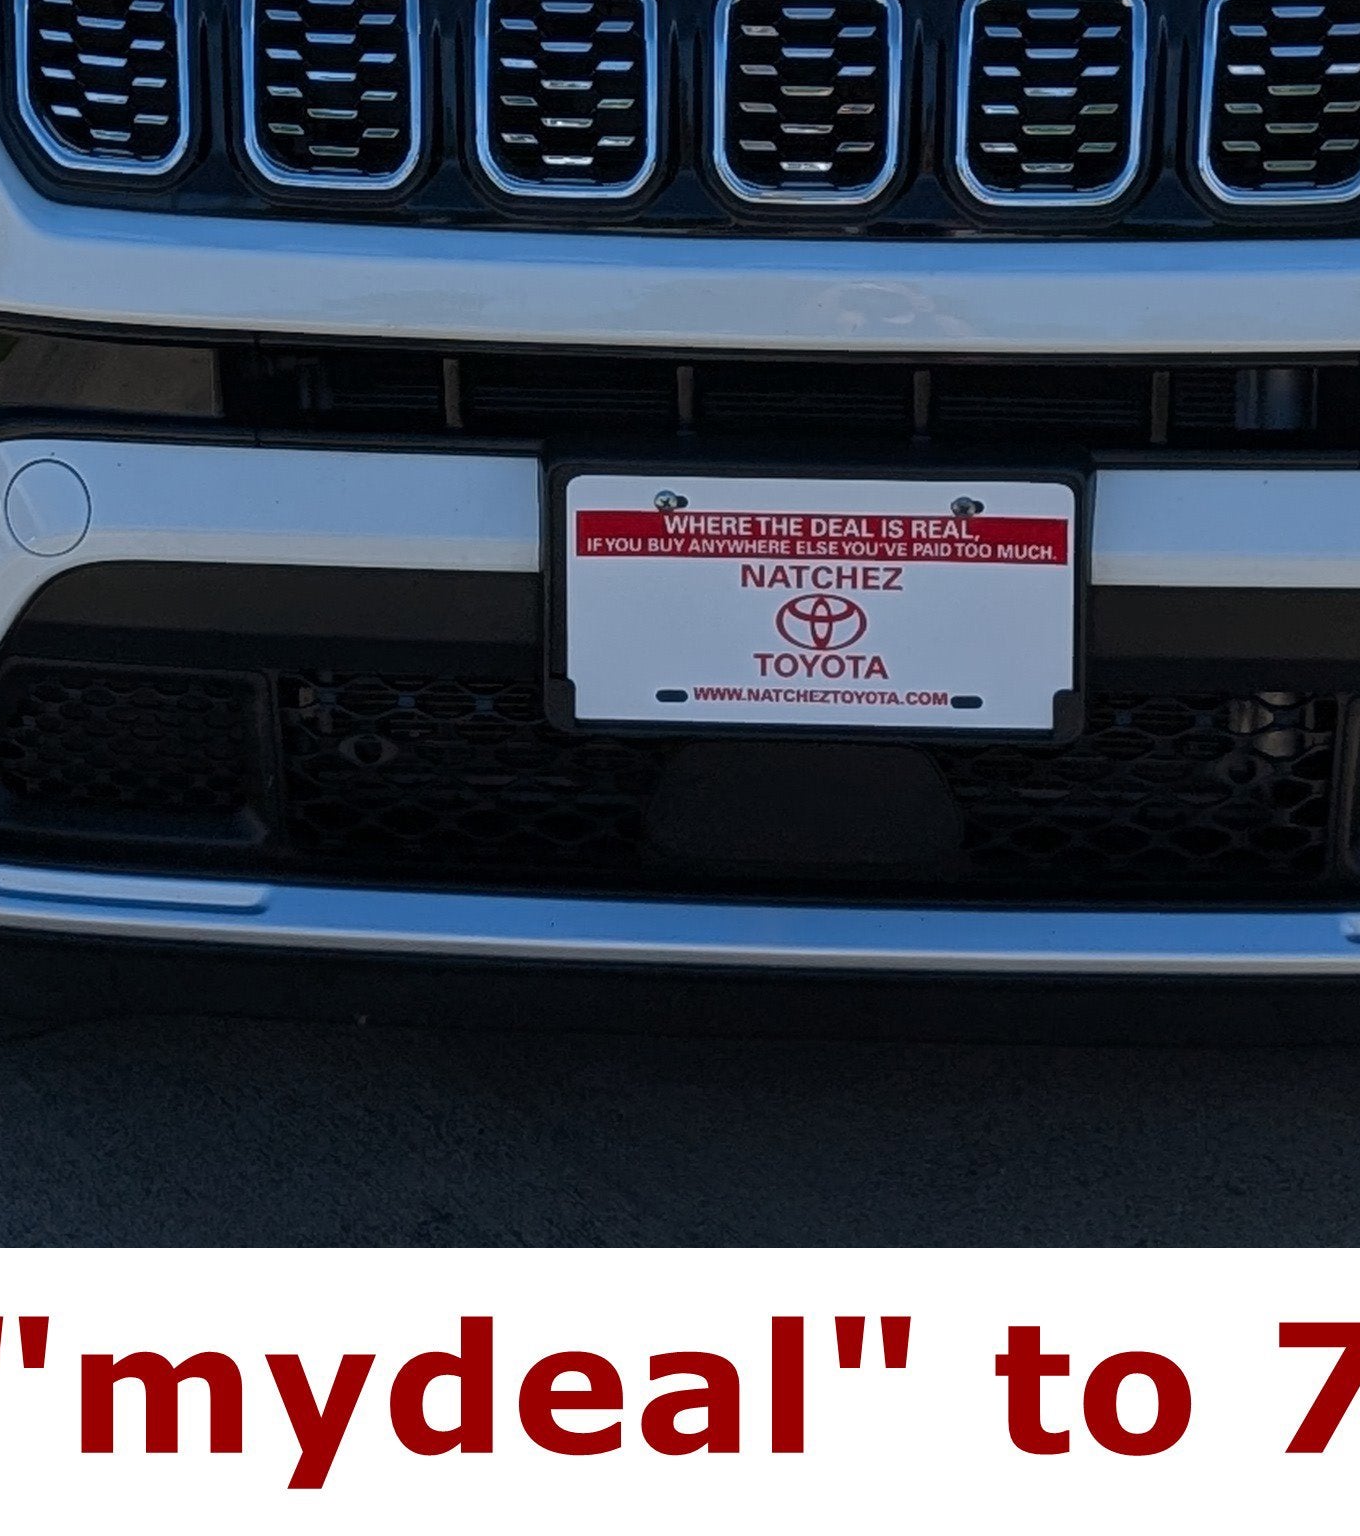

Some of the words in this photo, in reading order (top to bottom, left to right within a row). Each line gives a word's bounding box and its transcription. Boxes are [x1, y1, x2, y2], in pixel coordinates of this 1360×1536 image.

[664, 515, 752, 536] WHERE
[756, 517, 803, 537] THE
[810, 518, 875, 539] DEAL
[881, 520, 904, 539] IS
[911, 520, 981, 542] REAL,
[587, 537, 603, 552] IF
[604, 538, 641, 553] YOU
[647, 538, 686, 553] BUY
[688, 539, 791, 555] ANYWHERE
[796, 540, 839, 556] ELSE
[841, 541, 908, 557] YOU'VE
[912, 542, 952, 557] PAID
[955, 543, 992, 559] TOO
[996, 544, 1058, 561] MUCH.
[741, 564, 904, 591] NATCHEZ
[753, 653, 889, 680] TOYOTA
[693, 687, 948, 707] WWW.NATCHEZTOYOTA.COM
